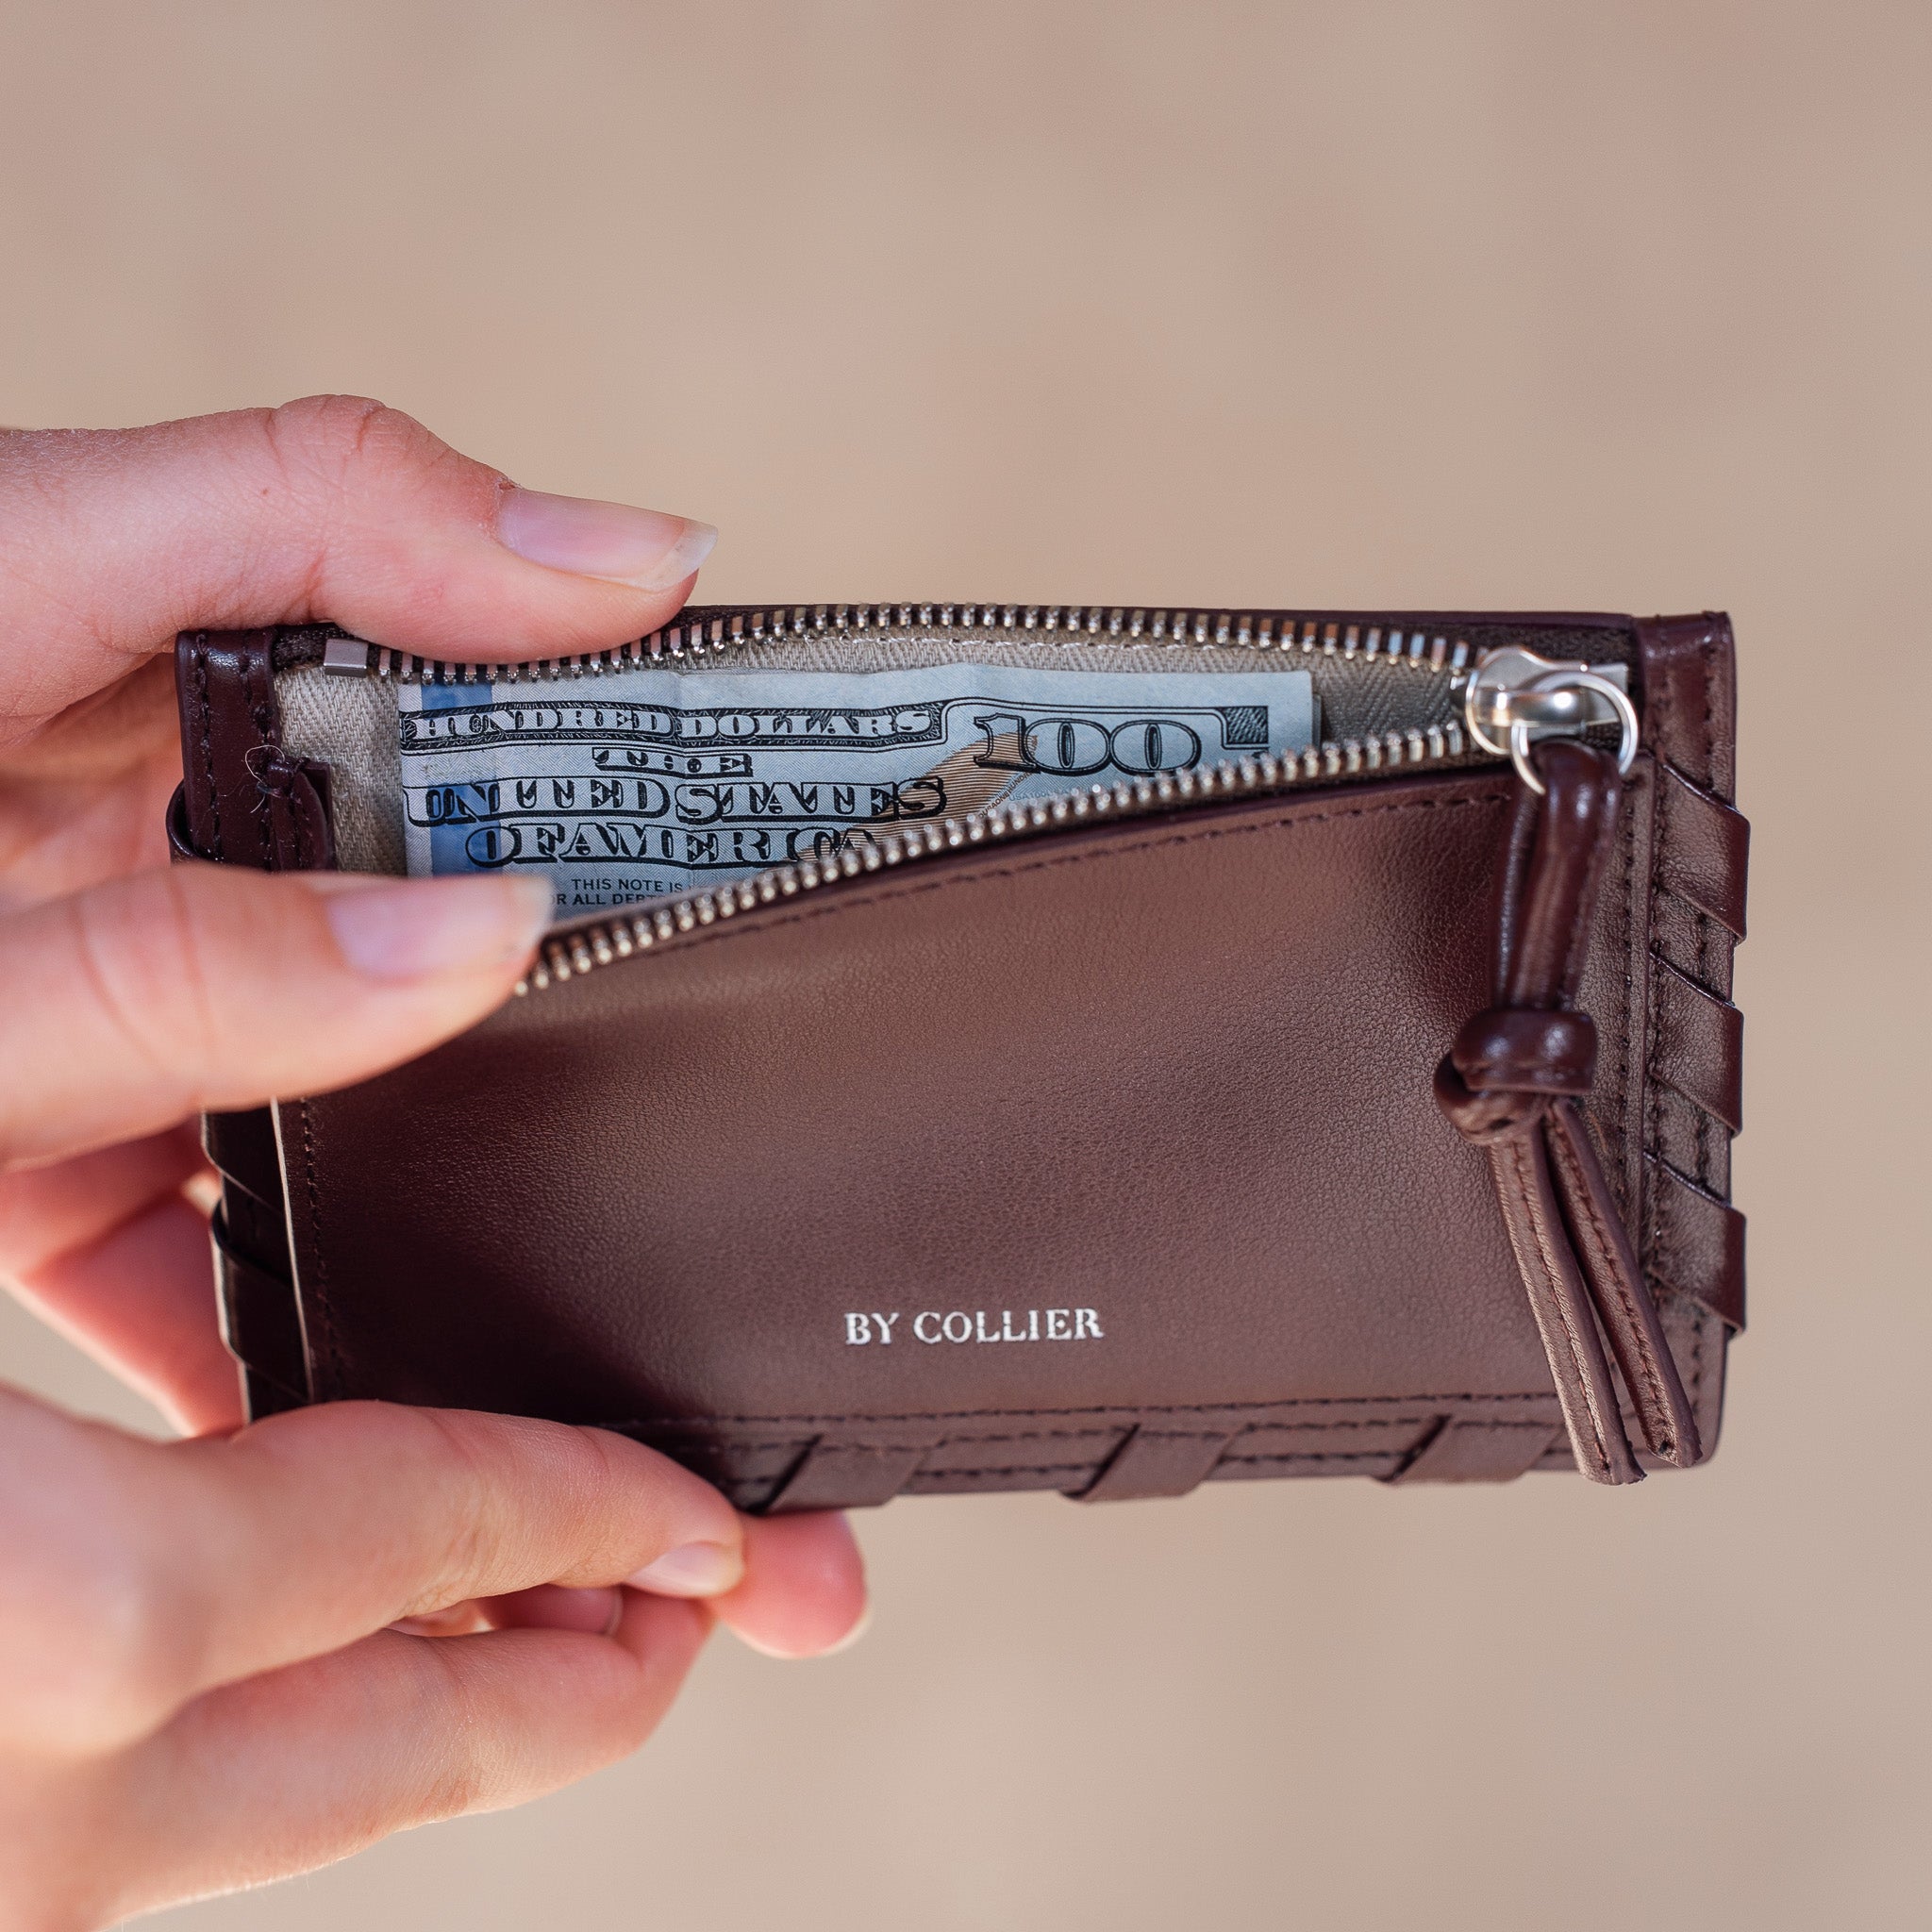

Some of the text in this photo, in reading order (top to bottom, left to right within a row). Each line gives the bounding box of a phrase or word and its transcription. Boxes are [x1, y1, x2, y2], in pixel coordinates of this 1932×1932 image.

[409, 708, 934, 741] HUNDRED DOLLARS
[974, 712, 1202, 776] 100
[591, 746, 753, 779] THE
[403, 775, 947, 826] UNITED STATES
[465, 823, 571, 867] OF
[572, 878, 683, 893] THIS NOTE IS
[572, 893, 607, 906] ALL
[844, 1308, 1105, 1345] BY COLLIER
